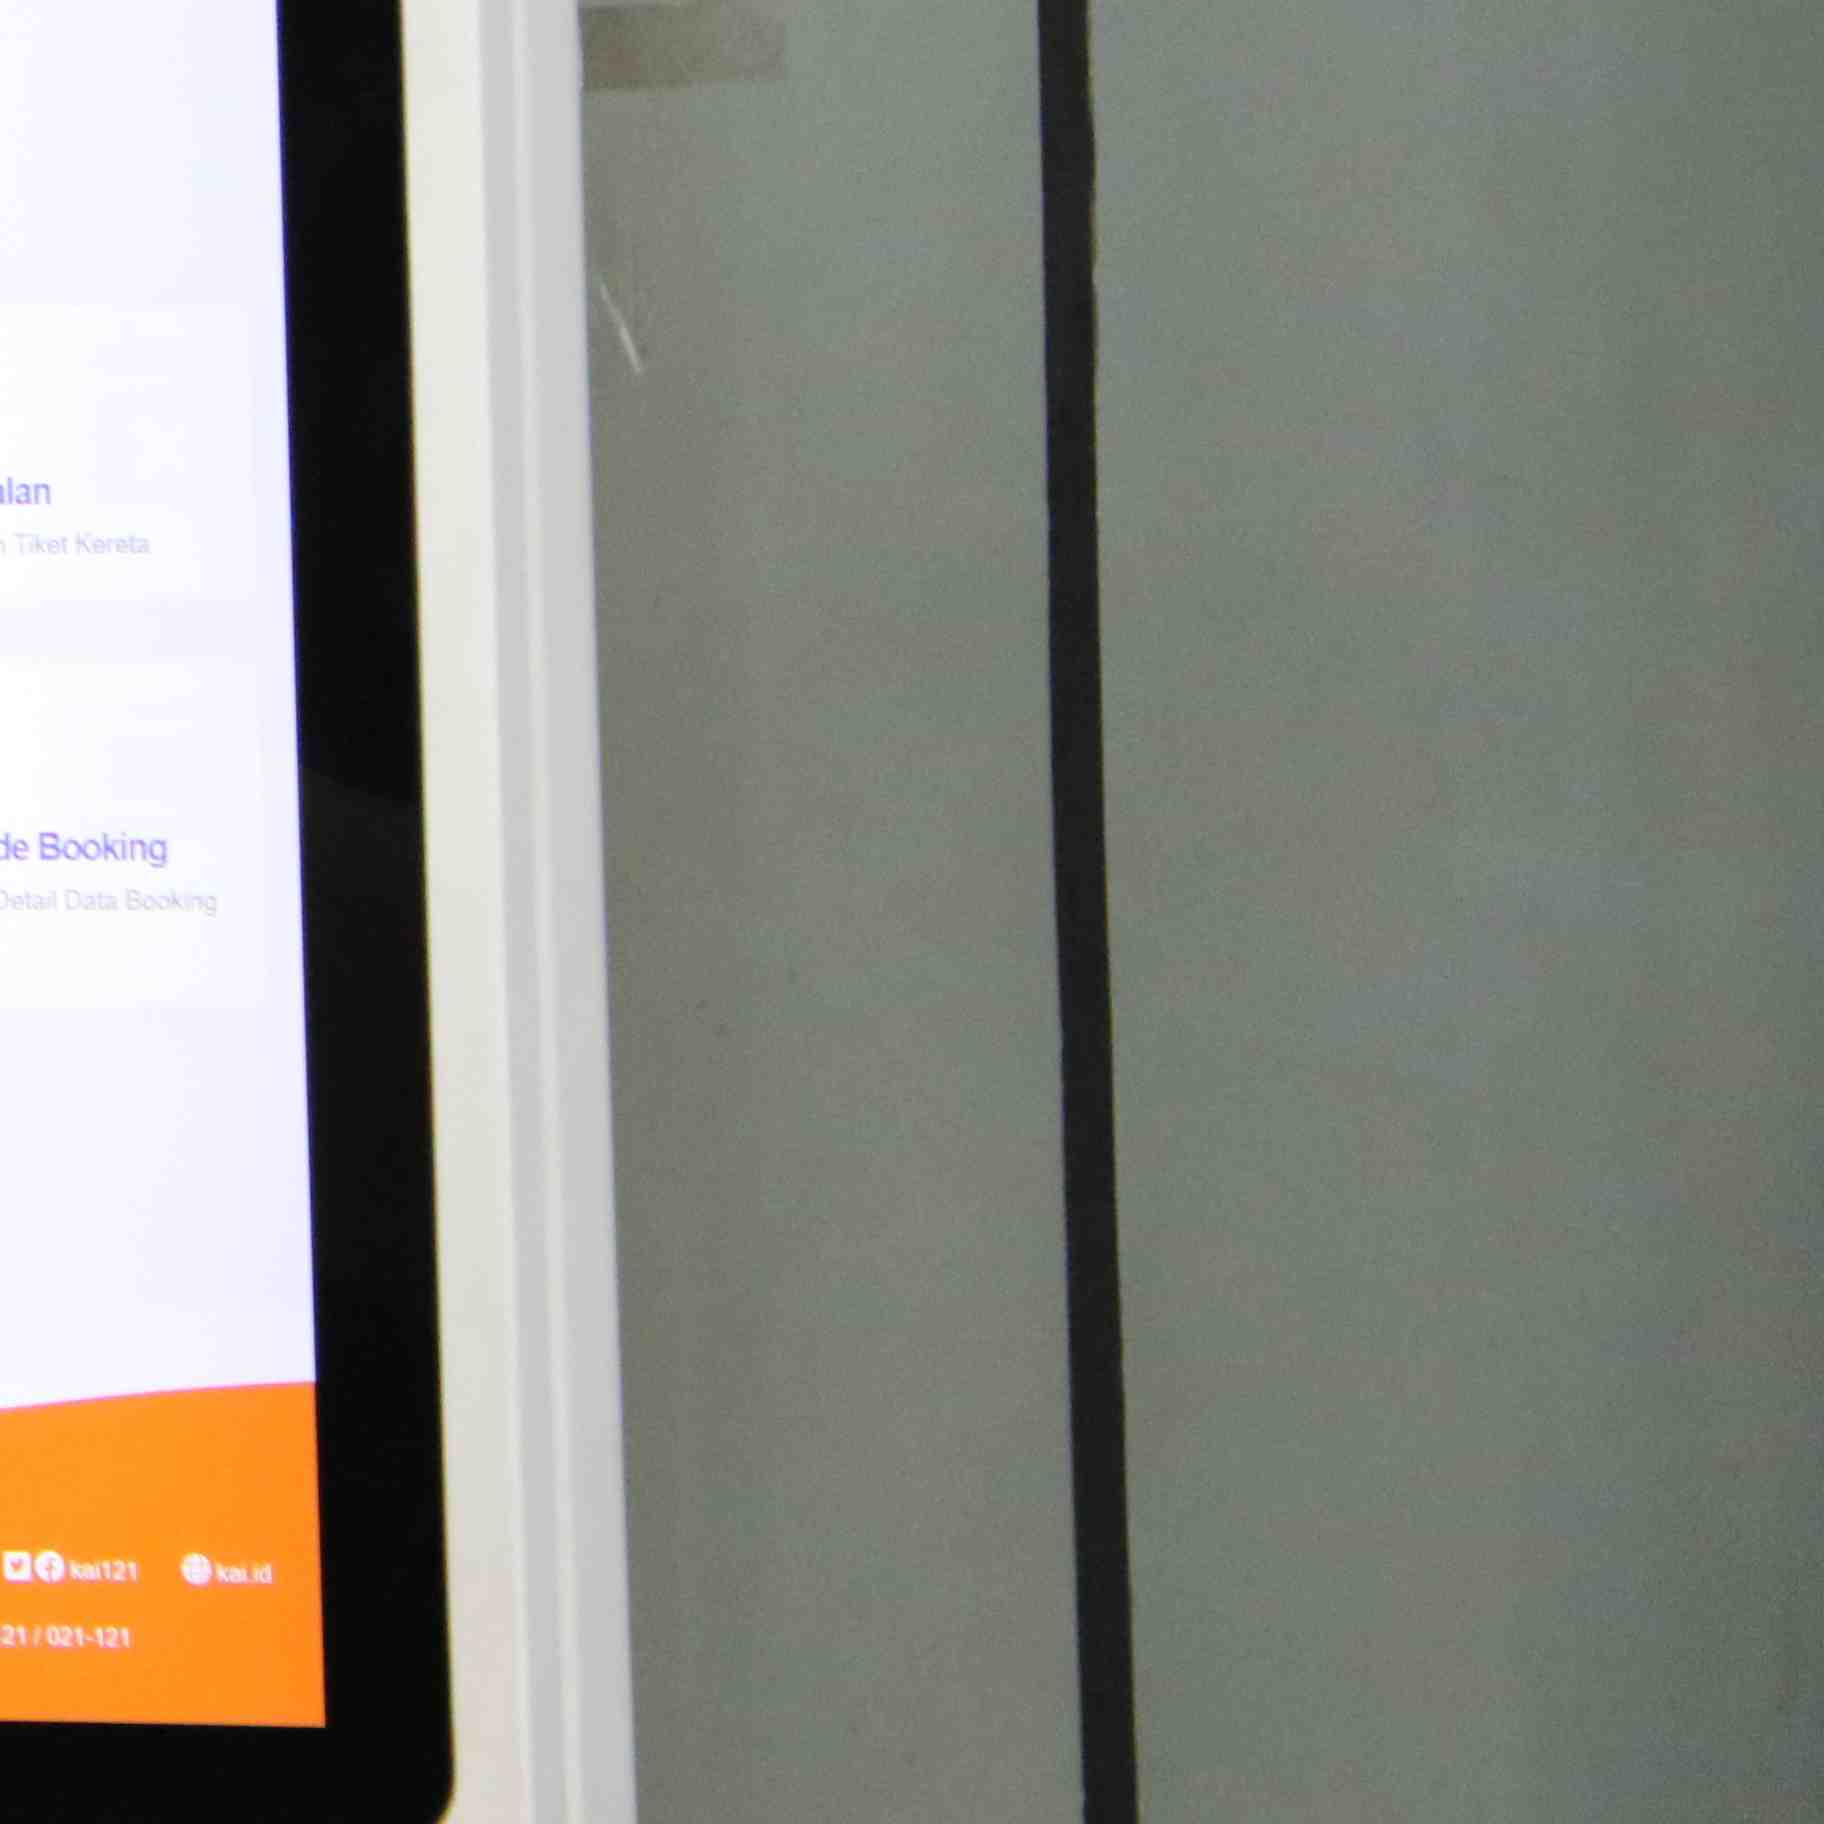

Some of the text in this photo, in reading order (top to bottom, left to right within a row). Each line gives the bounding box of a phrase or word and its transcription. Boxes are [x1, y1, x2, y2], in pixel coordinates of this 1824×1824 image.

[16, 533, 67, 554] Tiket
[76, 533, 149, 554] Kereta
[39, 833, 166, 867] Booking
[65, 889, 118, 910] Data
[126, 890, 216, 915] Booking
[69, 1558, 137, 1581] kai121
[217, 1562, 272, 1585] kai.id
[46, 1626, 129, 1647] 021-121
